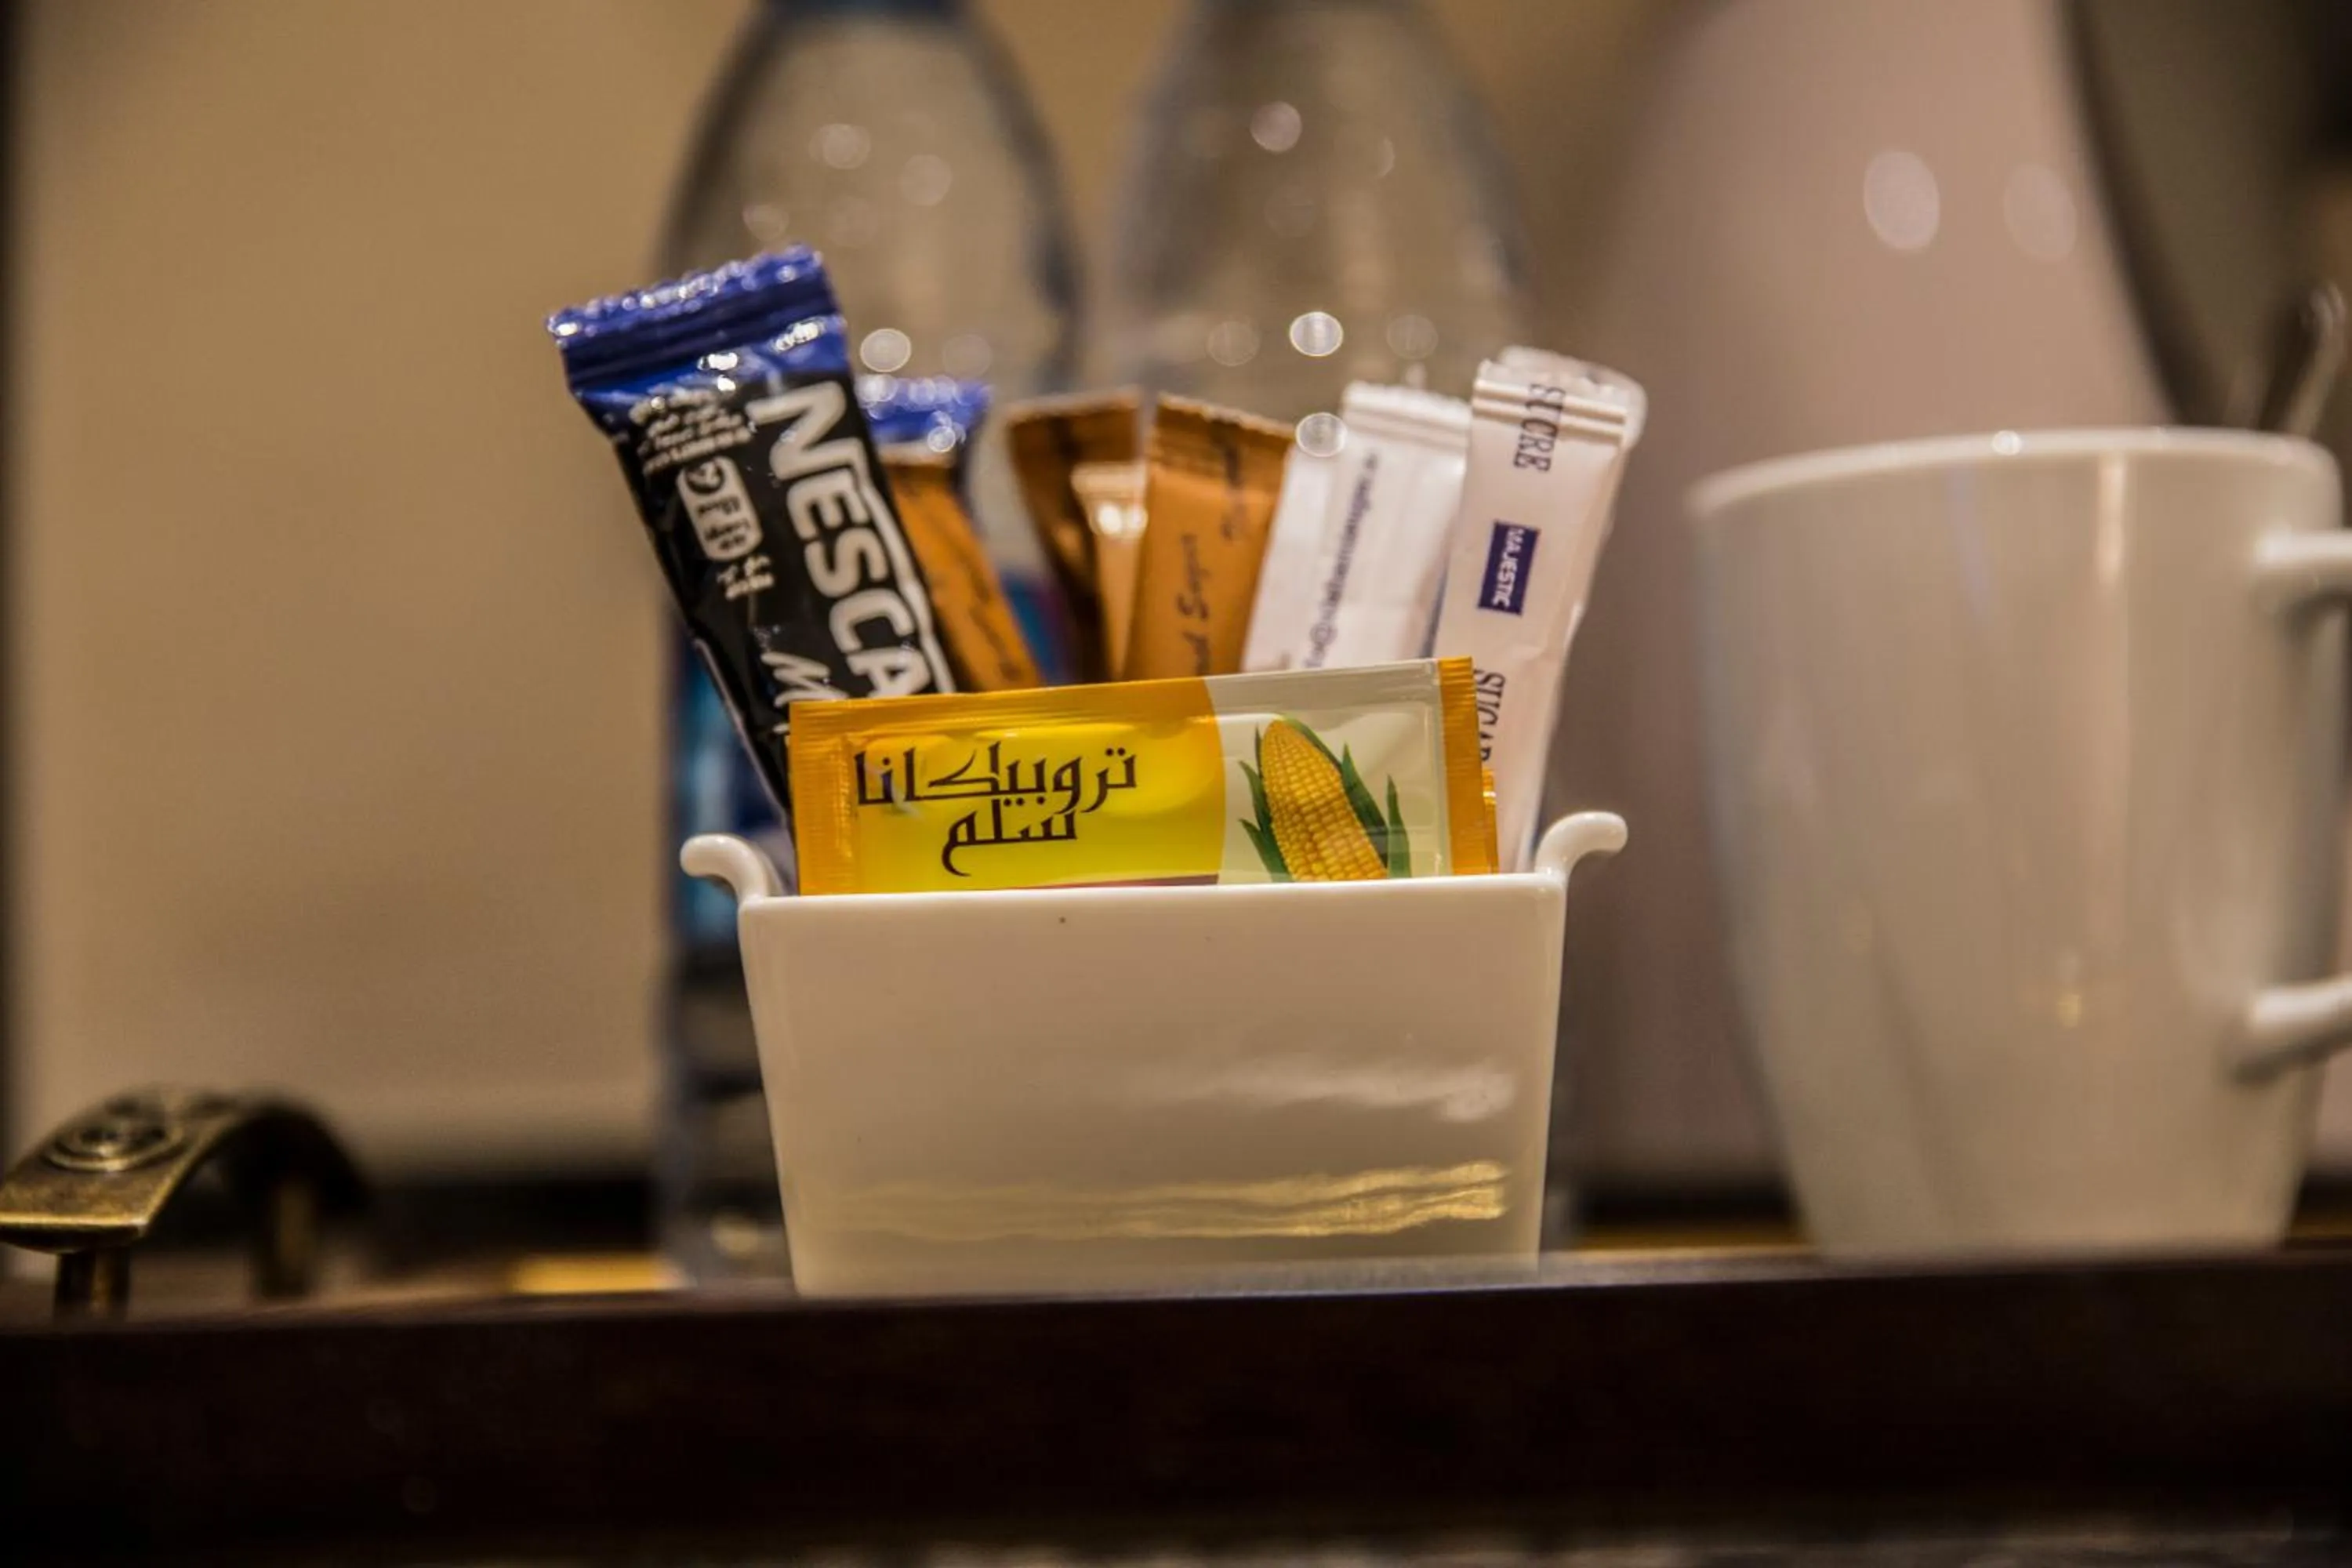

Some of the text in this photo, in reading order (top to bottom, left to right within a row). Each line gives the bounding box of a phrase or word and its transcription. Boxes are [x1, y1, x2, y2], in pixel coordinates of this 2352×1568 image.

[1513, 383, 1566, 471] SUCRE
[746, 381, 956, 697] NESCA
[1492, 528, 1525, 608] MAJESTIC
[855, 741, 1137, 814] تروبيكانا
